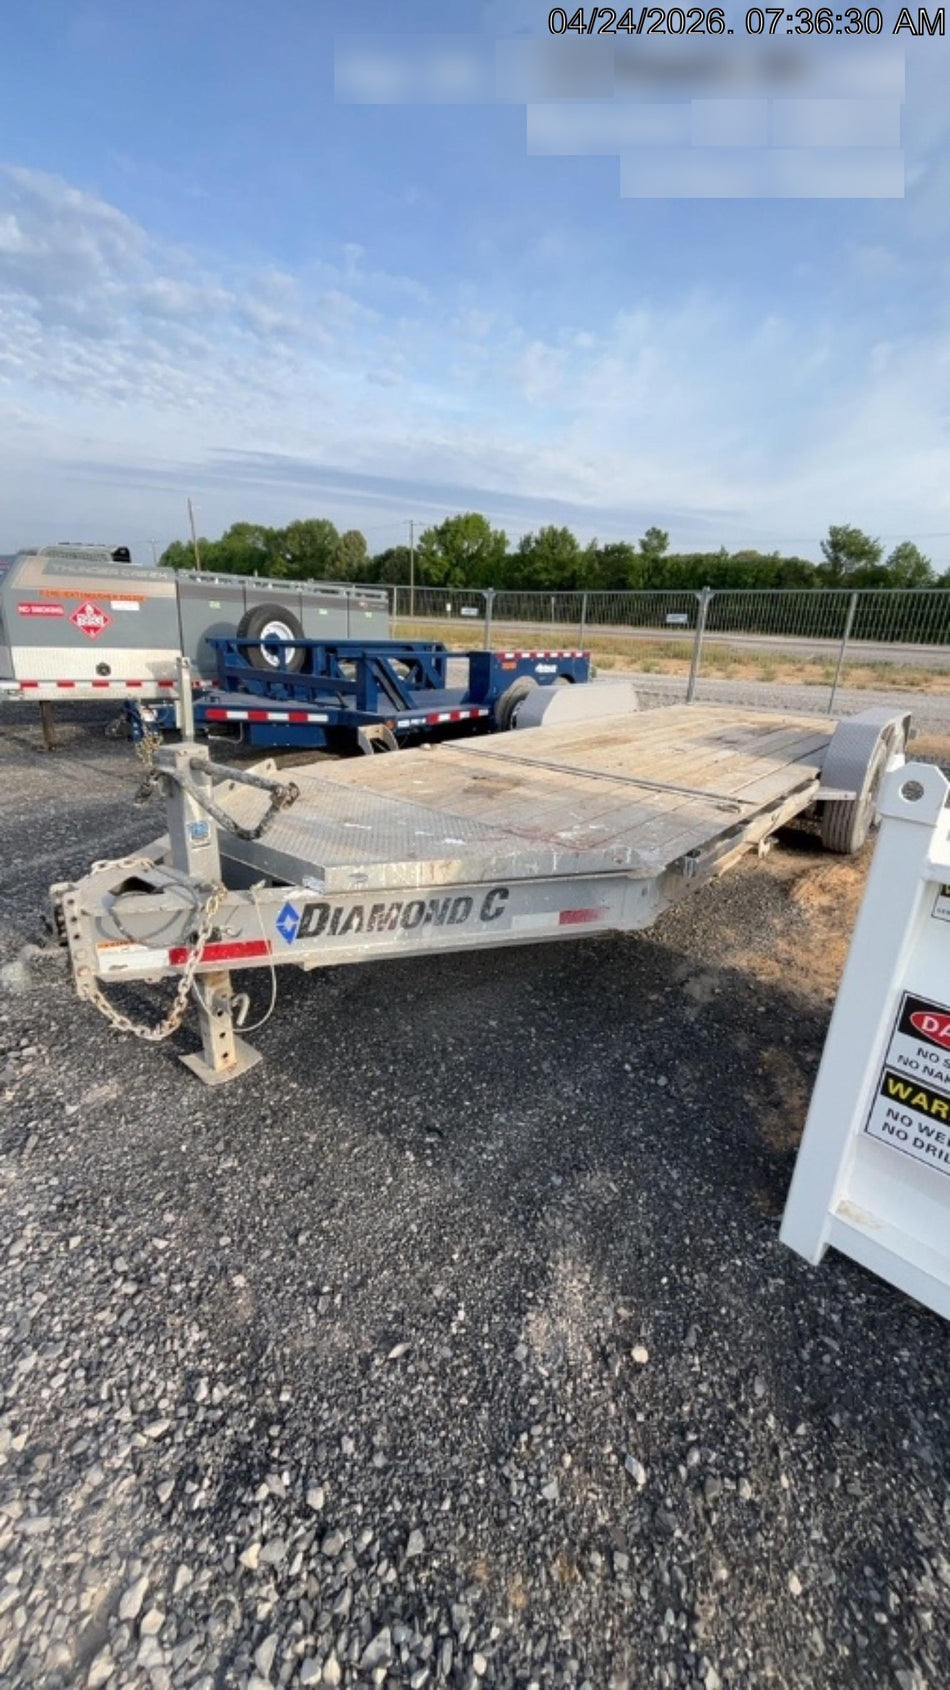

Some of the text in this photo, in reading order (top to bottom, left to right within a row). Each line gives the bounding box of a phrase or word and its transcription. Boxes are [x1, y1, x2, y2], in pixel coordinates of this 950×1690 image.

[296, 887, 510, 939] DIAMOND C
[897, 1054, 919, 1069] NO
[916, 1047, 940, 1063] NO
[886, 1107, 913, 1127] NO
[882, 1122, 909, 1141] NO
